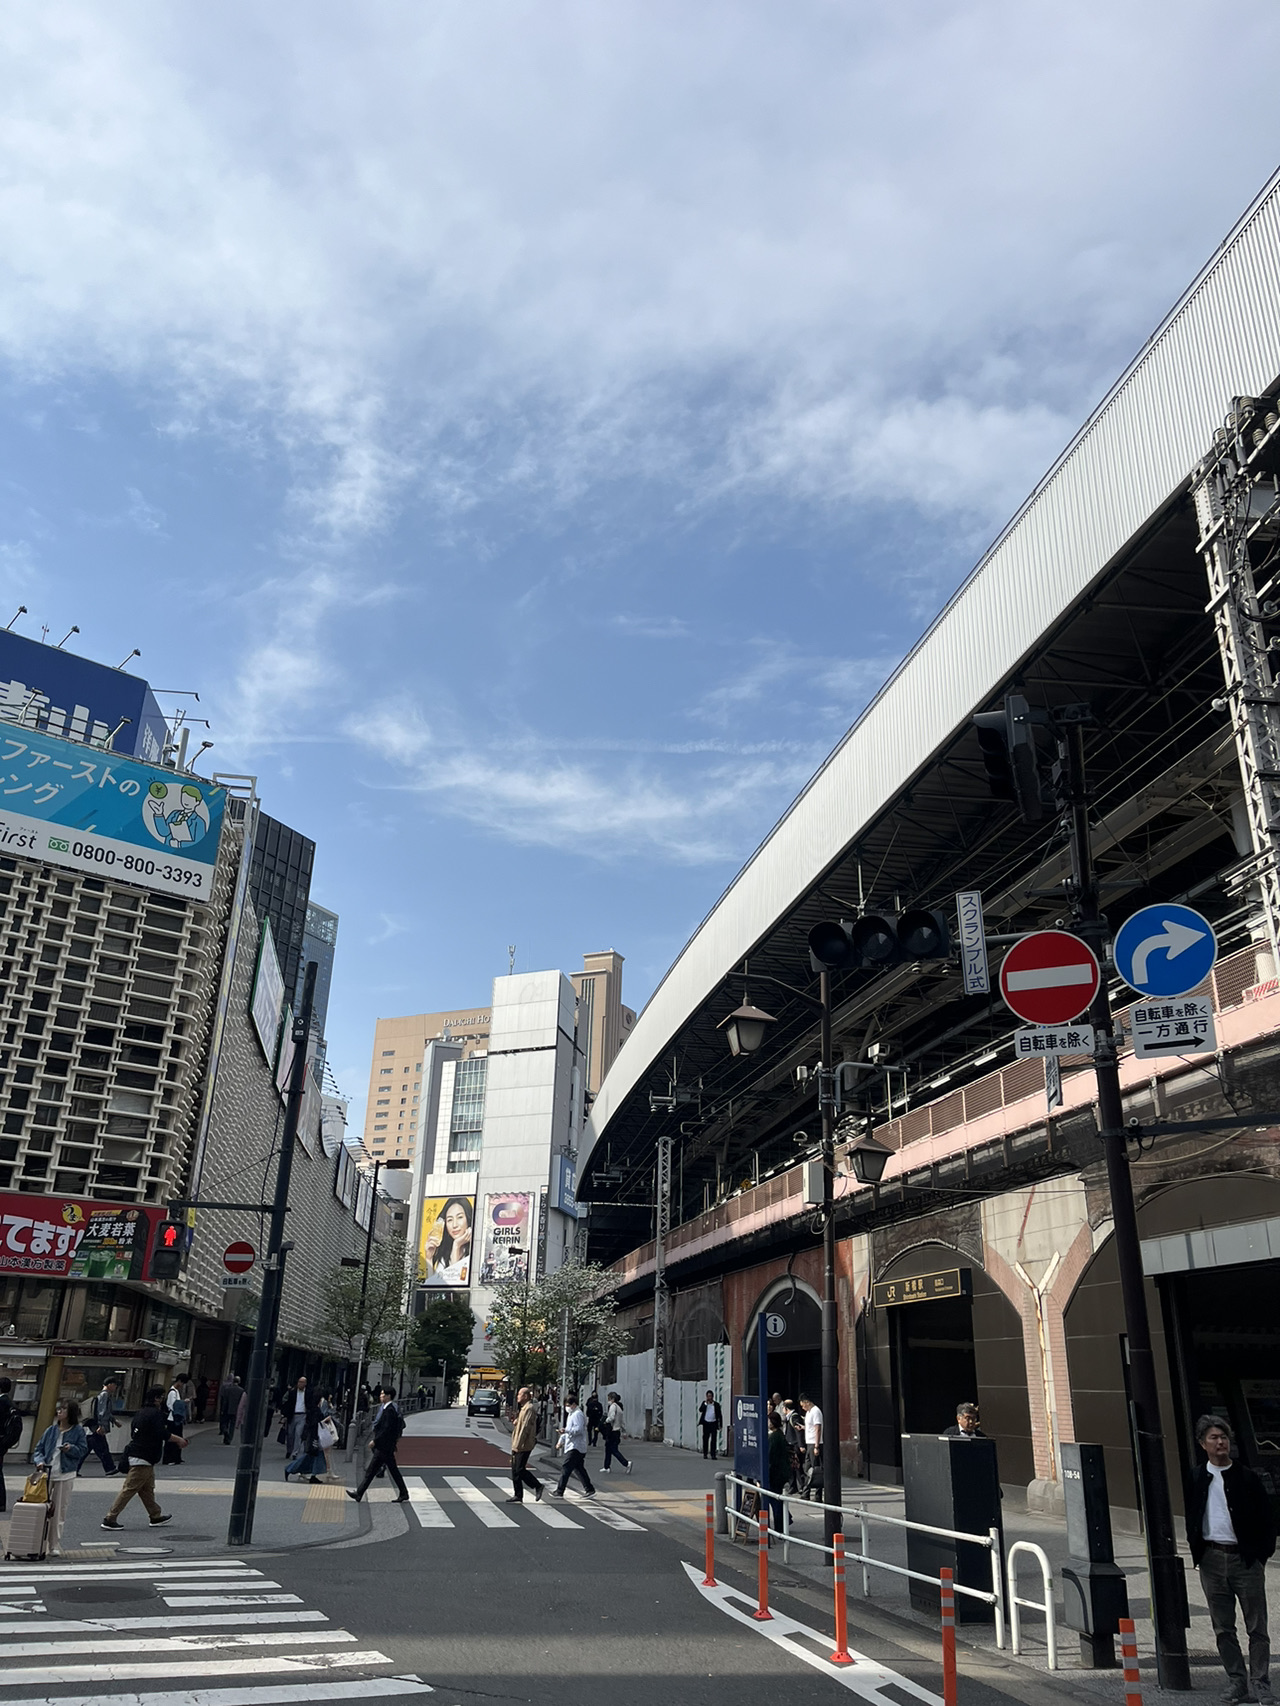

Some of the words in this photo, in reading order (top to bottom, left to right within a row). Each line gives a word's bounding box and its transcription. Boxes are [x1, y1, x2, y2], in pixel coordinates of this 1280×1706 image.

[0, 737, 141, 797] ファーストの
[0, 773, 64, 805] ング
[72, 841, 203, 888] 0800-800-3393
[962, 896, 985, 990] スクランブル式
[1134, 1002, 1208, 1023] 自転車を除く
[1138, 1019, 1209, 1039] 一方通行
[1020, 1031, 1090, 1052] 自転車を除く
[0, 1214, 85, 1258] てます!
[86, 1222, 137, 1237] 大麦若葉
[493, 1226, 521, 1236] GIRLS
[492, 1236, 521, 1245] KEIRIN
[0, 1256, 66, 1272] 山本漢方製薬
[886, 1286, 896, 1298] JR
